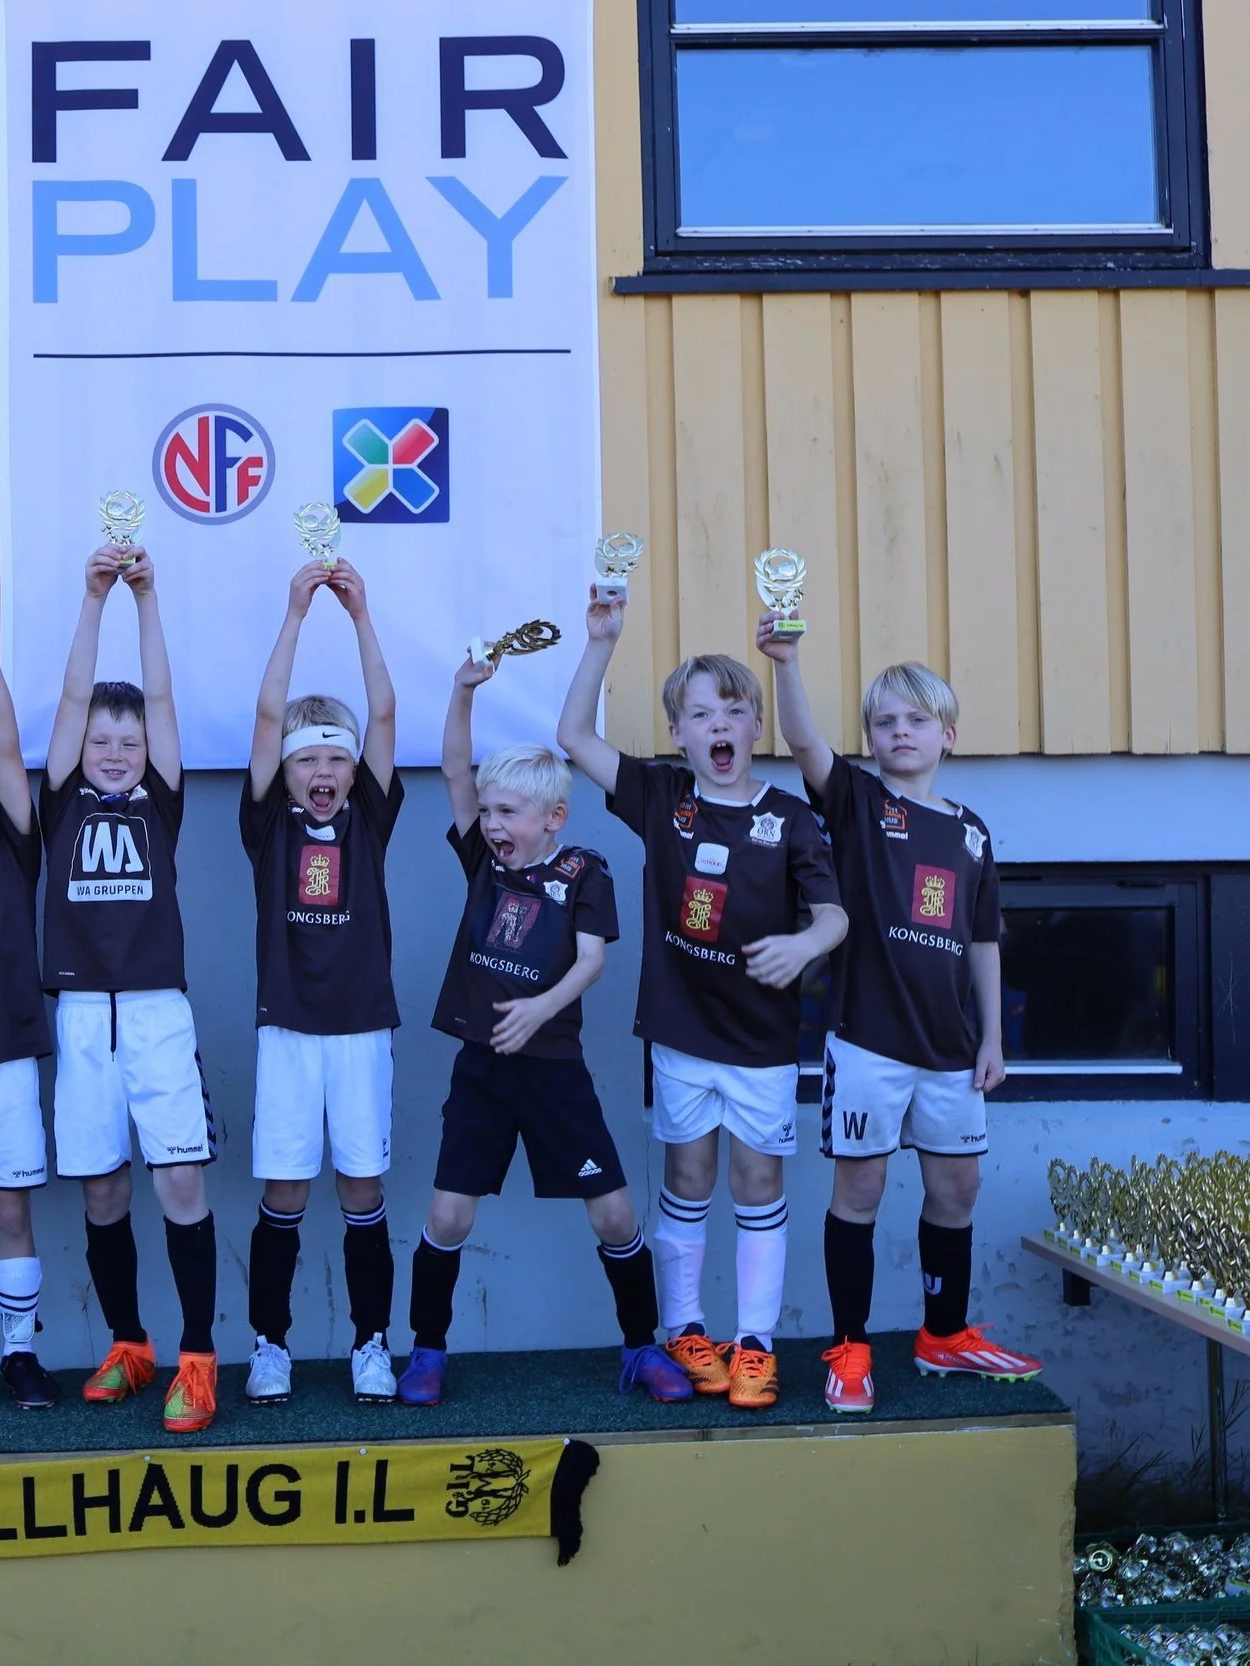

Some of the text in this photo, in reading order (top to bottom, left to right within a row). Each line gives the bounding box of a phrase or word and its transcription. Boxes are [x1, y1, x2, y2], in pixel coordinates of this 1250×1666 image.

[32, 35, 569, 163] FAIR
[32, 176, 570, 304] PLAY
[82, 822, 144, 873] WA
[77, 885, 144, 896] WA GRUPPEN
[665, 930, 736, 965] KONGSBERG
[470, 951, 539, 981] KONGSBERG
[843, 1111, 869, 1141] W
[176, 1144, 204, 1154] hummel
[335, 1458, 415, 1525] I.L
